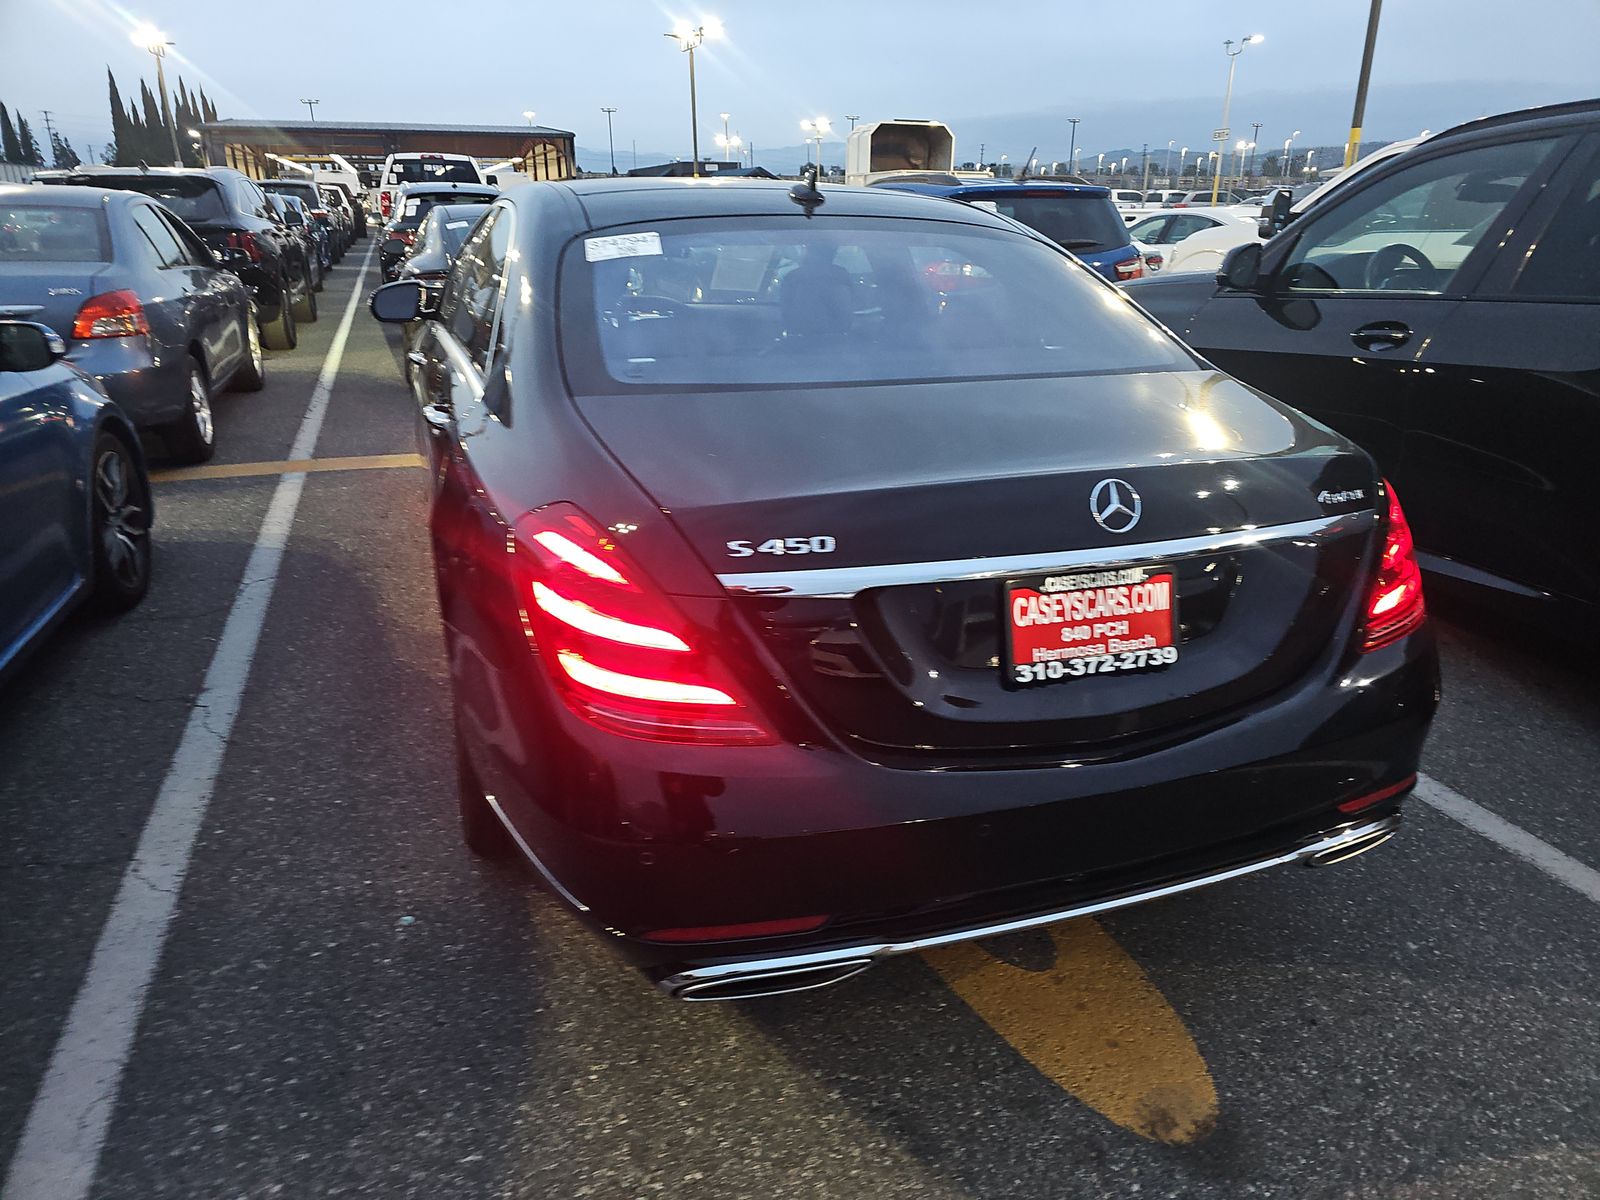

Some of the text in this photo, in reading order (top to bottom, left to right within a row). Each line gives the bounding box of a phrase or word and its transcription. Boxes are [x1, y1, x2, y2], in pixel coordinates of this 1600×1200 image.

[726, 535, 836, 557] S 450
[1013, 582, 1170, 626] CASEYSCARS.COM
[1093, 620, 1129, 638] PCH
[1032, 635, 1156, 662] Hermosa Beach
[1015, 647, 1178, 682] 310-372-2739
